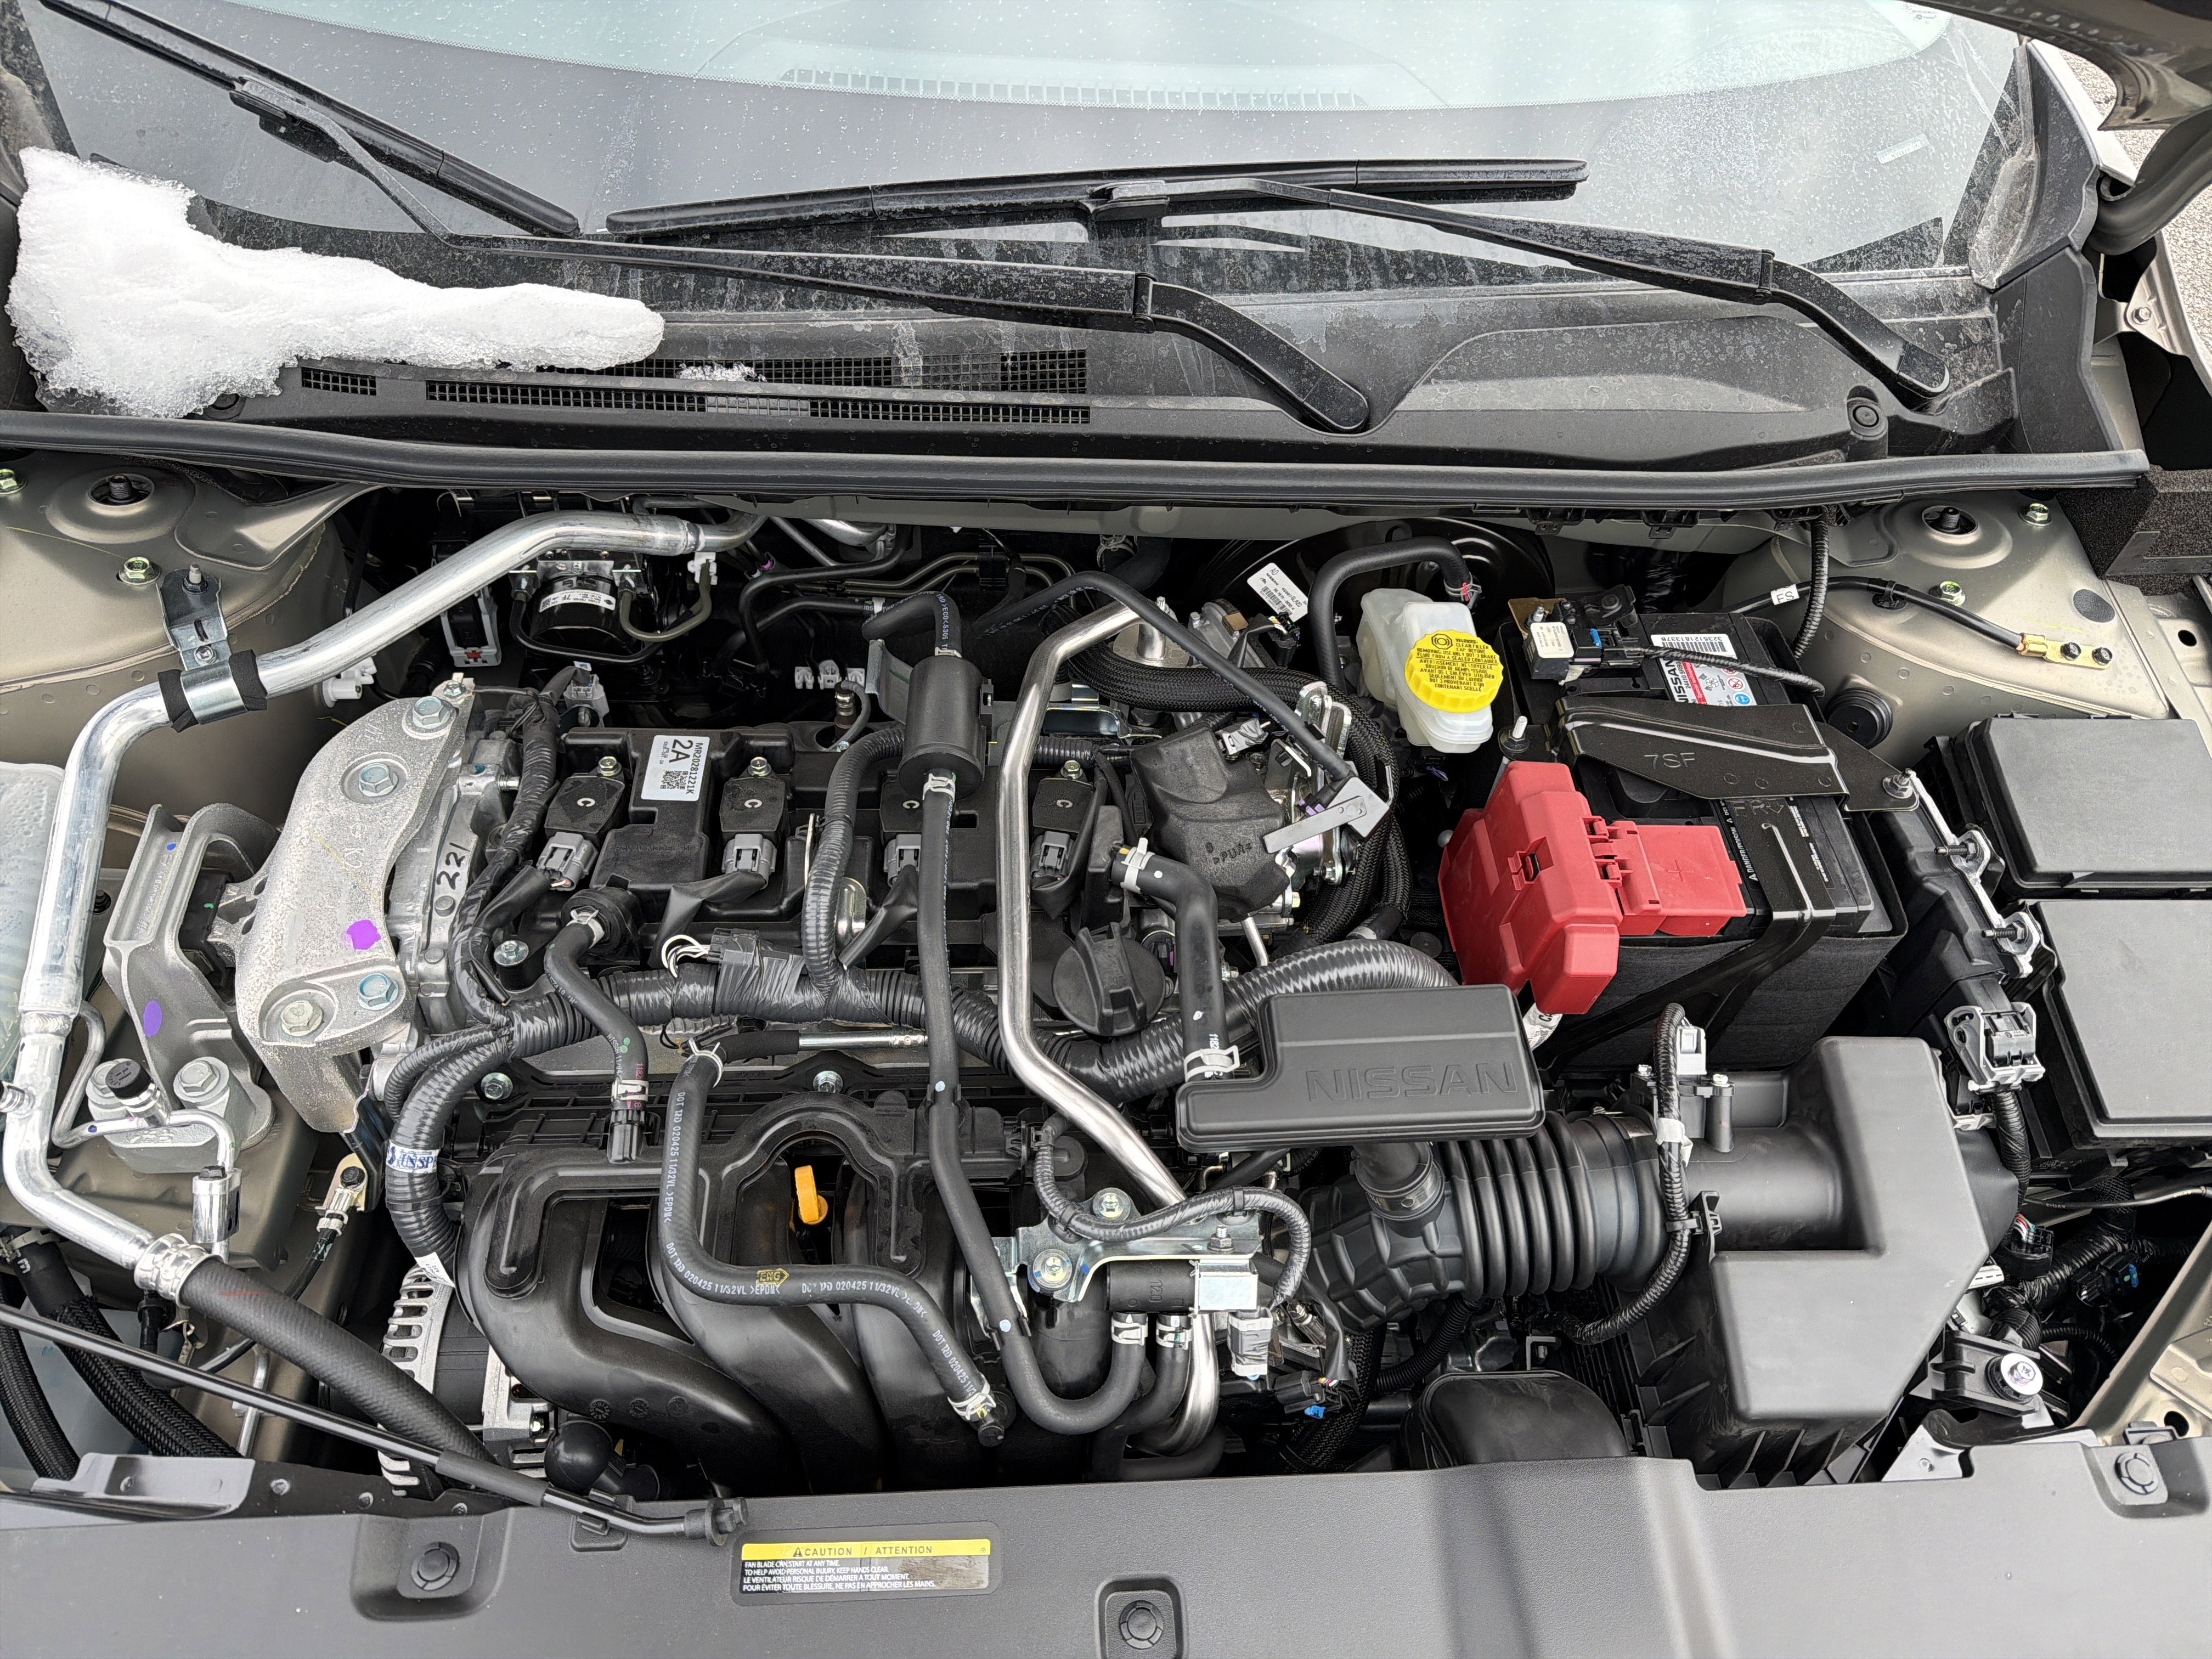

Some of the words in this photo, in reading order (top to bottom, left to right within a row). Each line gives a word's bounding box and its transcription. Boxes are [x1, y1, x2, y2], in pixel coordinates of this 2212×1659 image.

[1776, 591, 1795, 603] FS
[669, 739, 693, 763] 2A
[1644, 752, 1695, 769] 7SF
[1305, 1062, 1517, 1102] NISSAN
[676, 1092, 686, 1107] DOT
[670, 1126, 681, 1156] 020425
[666, 1242, 678, 1259] DOT
[684, 1270, 713, 1291] 020425
[759, 1272, 781, 1282] ENG
[836, 1280, 867, 1291] 020425
[933, 1329, 946, 1345] DOT
[949, 1357, 969, 1383] 020425
[804, 1548, 852, 1556] CAUTION
[876, 1546, 932, 1554] ATTENTION
